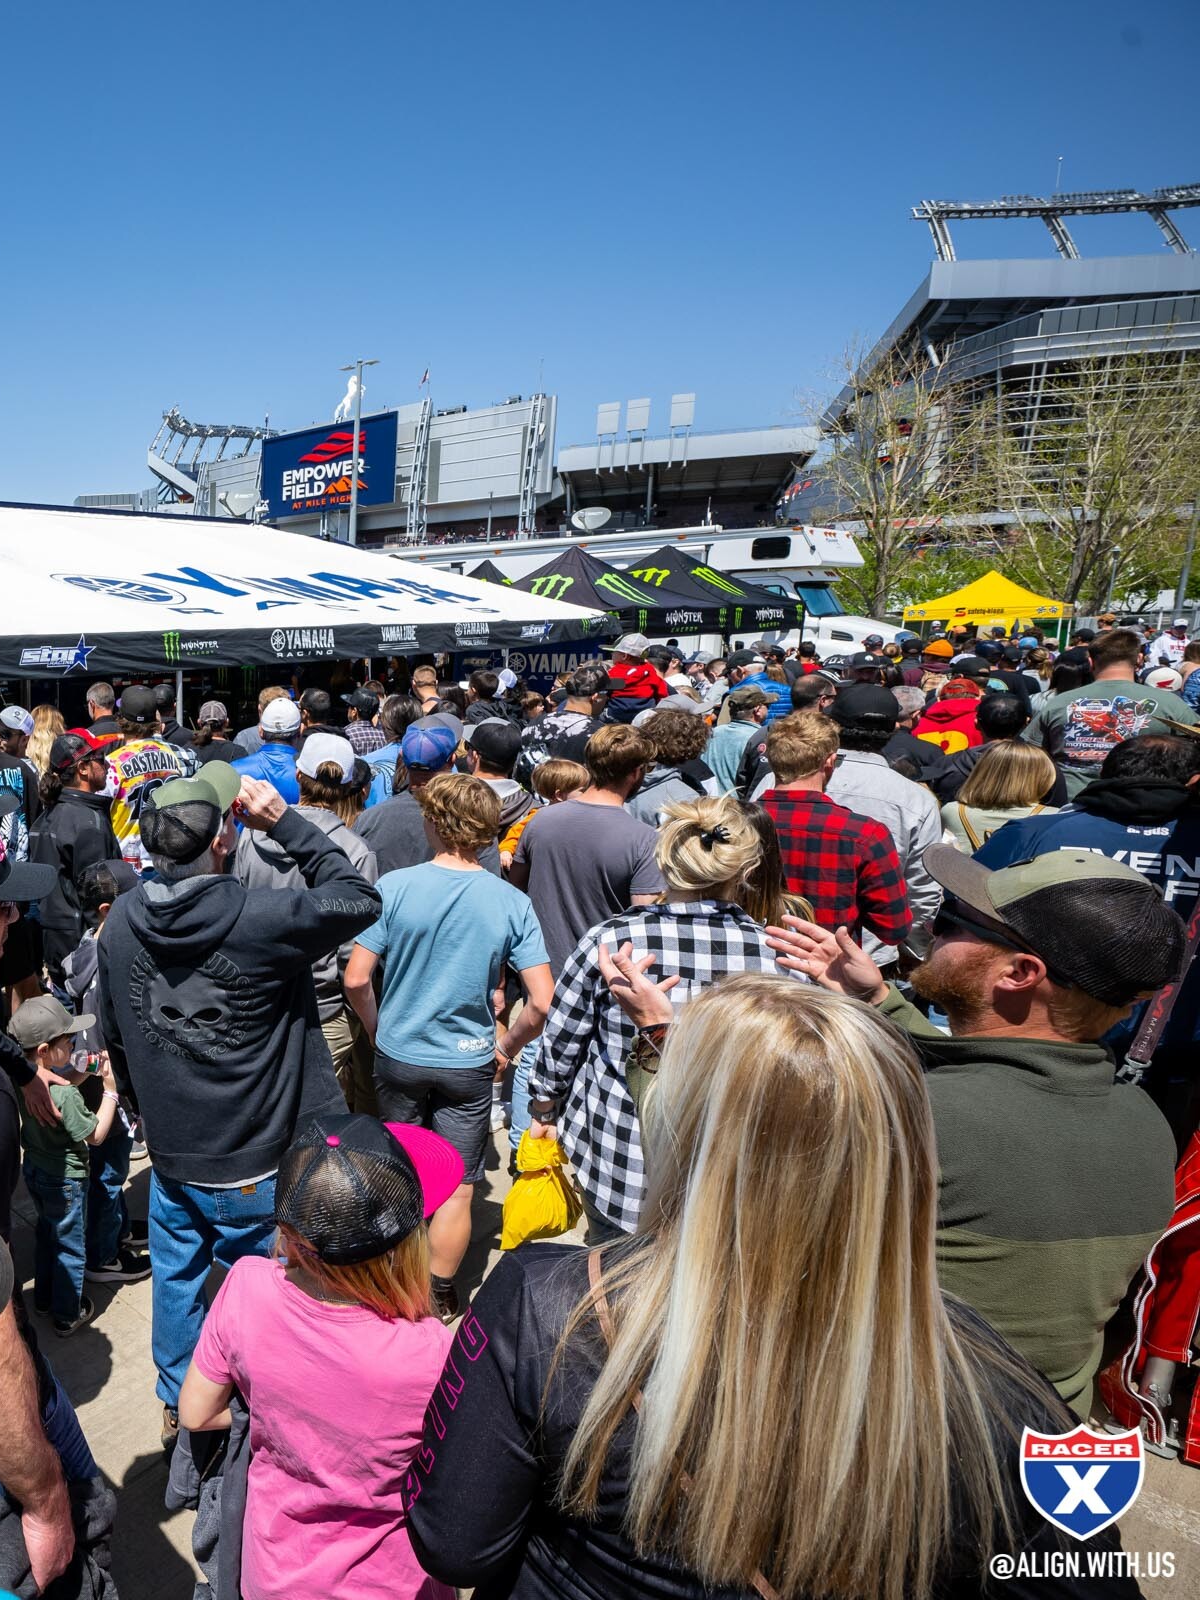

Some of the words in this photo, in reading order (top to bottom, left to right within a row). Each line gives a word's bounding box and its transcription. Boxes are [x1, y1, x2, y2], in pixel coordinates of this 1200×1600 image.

[282, 481, 326, 501] FIELD
[292, 502, 303, 510] AT
[306, 498, 327, 509] MILE
[665, 610, 703, 625] MONSTER
[755, 607, 785, 621] MONSTER
[381, 625, 418, 641] YAMALUBE
[463, 622, 490, 635] YAMAHA
[181, 640, 219, 649] MONSTER
[286, 629, 335, 649] YAMAHA
